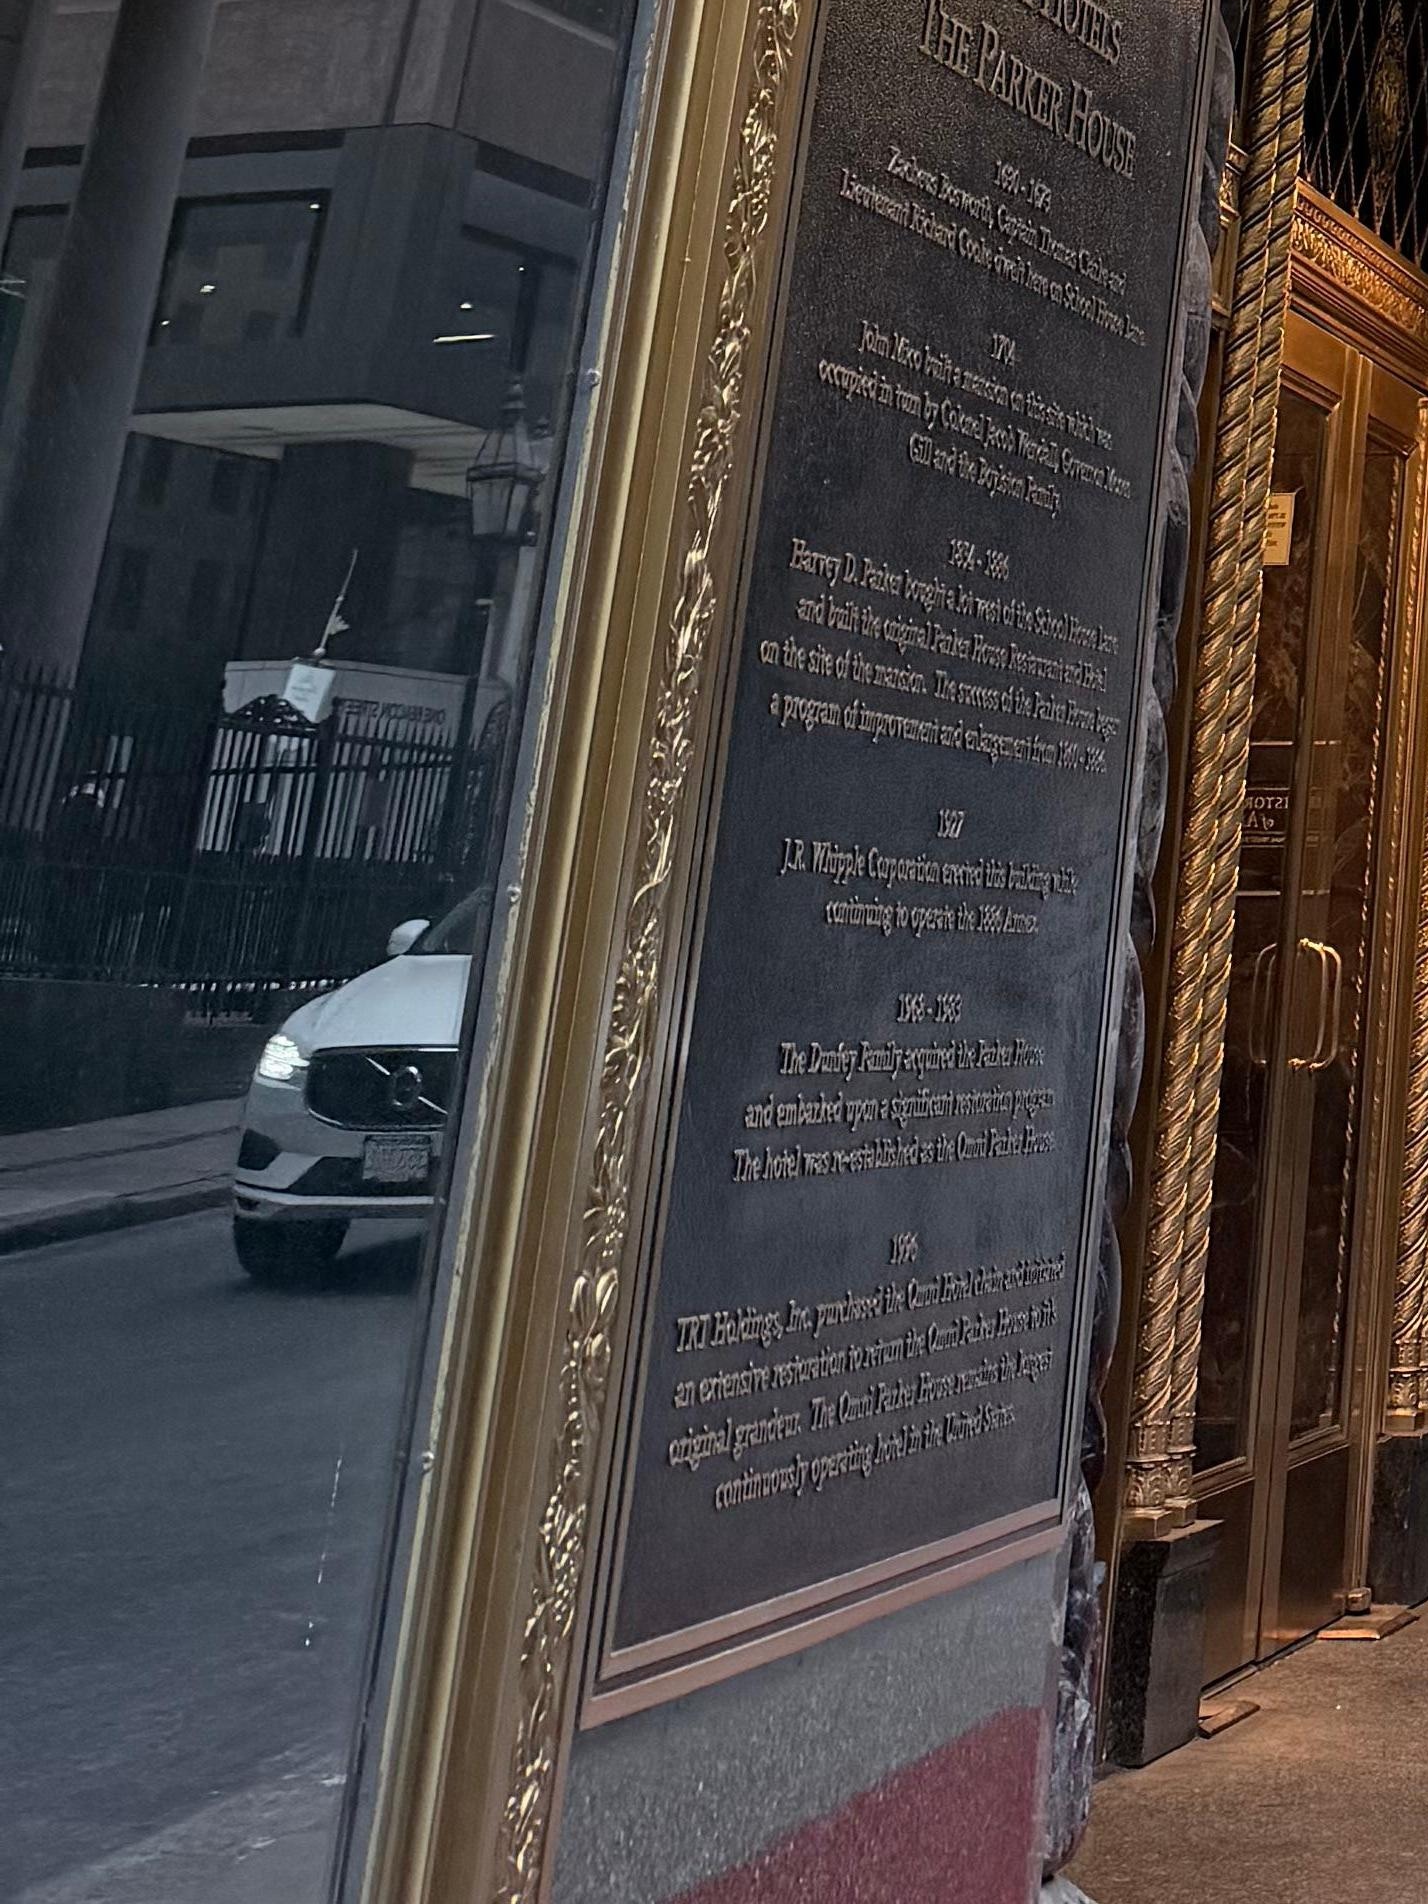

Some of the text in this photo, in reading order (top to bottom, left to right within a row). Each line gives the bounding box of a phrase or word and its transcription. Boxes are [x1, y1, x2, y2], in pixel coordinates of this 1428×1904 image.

[975, 21, 1065, 136] PARKER
[1066, 79, 1137, 180] HOUSE
[841, 168, 909, 228] Lieutenant
[911, 204, 957, 251] Richard
[1027, 263, 1049, 298] here
[998, 204, 1076, 269] Captain Thomas
[819, 359, 878, 402] occupied
[880, 375, 893, 406] in
[923, 393, 939, 433] by
[860, 320, 1046, 422] John built mansion on this
[909, 432, 976, 482] Gill and the
[790, 538, 841, 588] Harvey
[844, 553, 857, 584] D.
[862, 558, 902, 596] Parker
[904, 570, 946, 613] bought
[958, 585, 973, 615] lot
[977, 598, 1002, 622] west
[1003, 600, 1015, 626] of
[797, 594, 1008, 668] and built the original Parker House
[760, 640, 780, 665] on
[782, 639, 807, 670] the
[808, 645, 833, 676] site
[836, 651, 851, 679] of
[852, 654, 874, 684] the
[875, 665, 926, 696] mansion.
[934, 671, 956, 702] The
[958, 684, 1000, 711] success
[1002, 688, 1013, 713] of
[782, 695, 841, 731] program
[844, 701, 859, 729] of
[860, 702, 940, 744] improvement
[941, 721, 964, 748] and
[965, 725, 1032, 763] enlargement
[938, 807, 964, 839] 1927
[811, 840, 867, 883] Whipple
[868, 846, 940, 887] Corporation
[944, 857, 984, 886] erected
[827, 895, 977, 936] continuing to operate the
[779, 1042, 807, 1073] The
[809, 1041, 857, 1081] Dunfey
[903, 1039, 957, 1078] acquired
[957, 1039, 976, 1068] the
[746, 1094, 774, 1127] and
[776, 1090, 845, 1125] embarked
[845, 1098, 879, 1129] upon
[891, 1085, 954, 1126] significant
[732, 1148, 762, 1182] The
[764, 1144, 802, 1179] hotel
[802, 1152, 831, 1175] was
[832, 1135, 920, 1172] re-established
[920, 1143, 935, 1164] as
[936, 1132, 955, 1162] the
[675, 1313, 709, 1353] TRT
[711, 1305, 782, 1346] Holdings,
[787, 1298, 812, 1331] Inc.
[885, 1279, 906, 1312] the
[907, 1272, 941, 1307] Omni
[675, 1381, 696, 1408] an
[700, 1358, 770, 1403] extensive
[772, 1342, 847, 1387] restoration
[848, 1341, 863, 1370] to
[864, 1335, 904, 1366] return
[905, 1324, 926, 1357] the
[668, 1417, 733, 1471] original
[733, 1406, 801, 1459] grandeur.
[809, 1394, 836, 1430] The
[838, 1383, 875, 1423] Omni
[876, 1376, 917, 1413] Parker
[715, 1454, 808, 1511] continuously
[811, 1437, 874, 1490] operating
[876, 1424, 908, 1463] hotel
[909, 1422, 922, 1453] in
